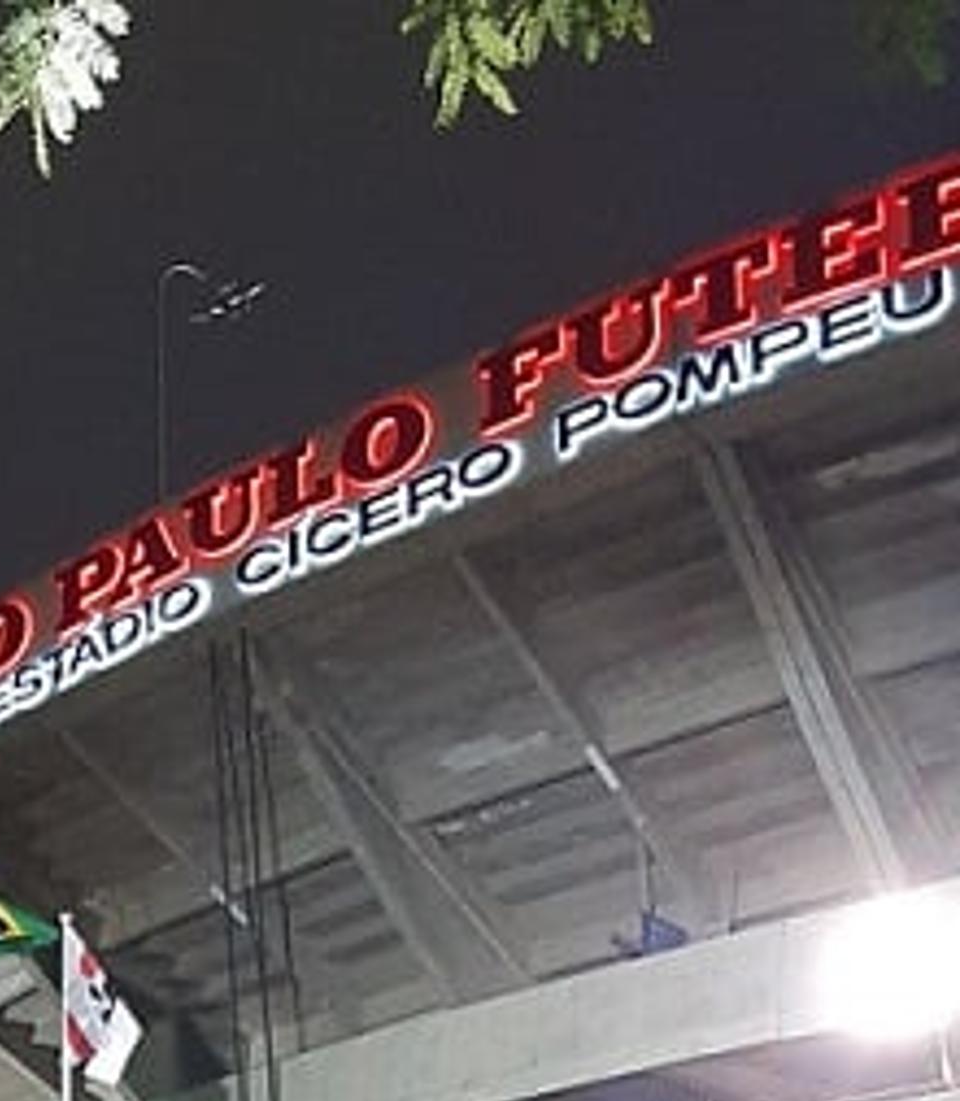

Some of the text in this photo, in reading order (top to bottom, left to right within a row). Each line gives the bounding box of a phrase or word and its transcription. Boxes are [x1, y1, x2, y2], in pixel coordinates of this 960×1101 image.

[52, 396, 432, 640] PAULO
[236, 440, 522, 597] CICERO
[554, 268, 954, 460] POMPEU
